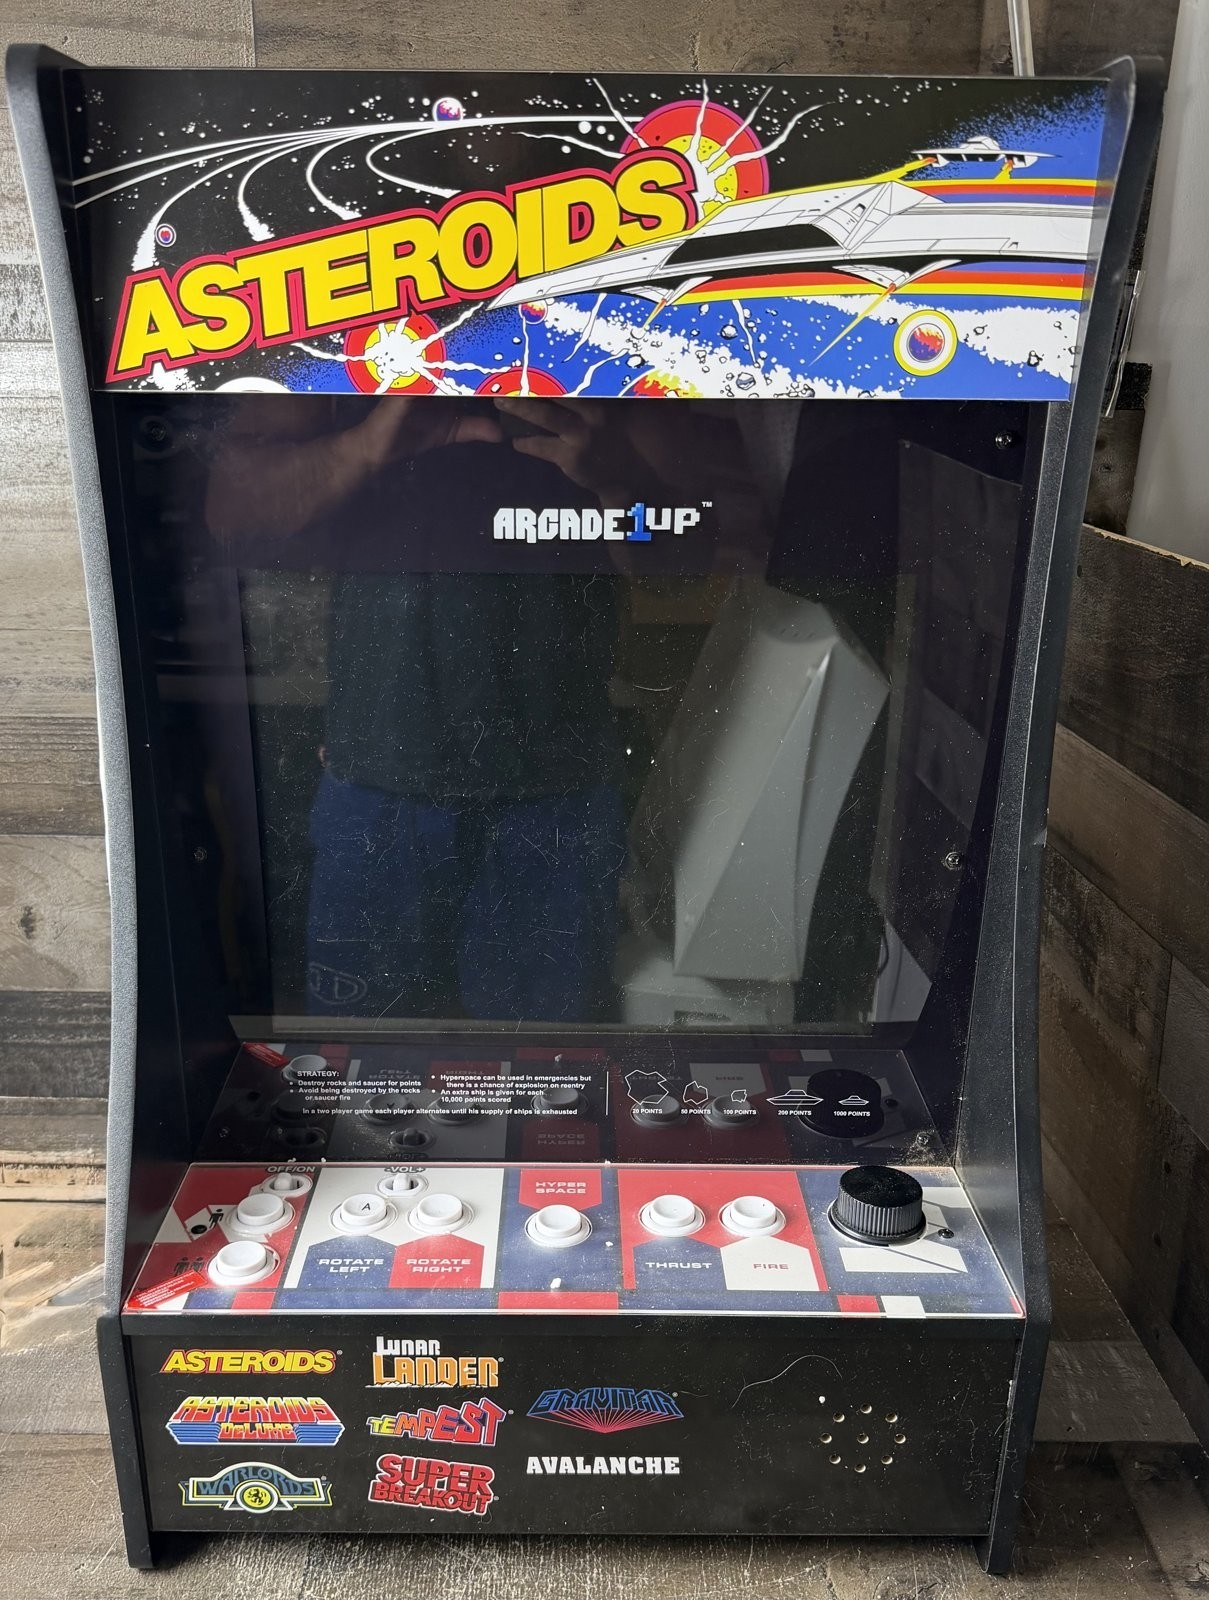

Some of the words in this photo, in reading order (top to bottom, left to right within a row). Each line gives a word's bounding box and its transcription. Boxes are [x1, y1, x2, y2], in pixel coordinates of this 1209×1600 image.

[107, 148, 696, 379] ASTEROIDS
[362, 1202, 372, 1211] A
[161, 1349, 336, 1374] ASTEROIDS
[372, 1351, 499, 1388] LANDER
[171, 1396, 341, 1423] ASTEROIDS
[527, 1387, 684, 1418] GRAVITAR
[366, 1397, 506, 1447] TEMPEST
[198, 1466, 315, 1495] WARLORDS
[376, 1454, 495, 1496] SUPER
[526, 1456, 680, 1475] AVALANCHE
[369, 1480, 493, 1516] BREAKOUT
